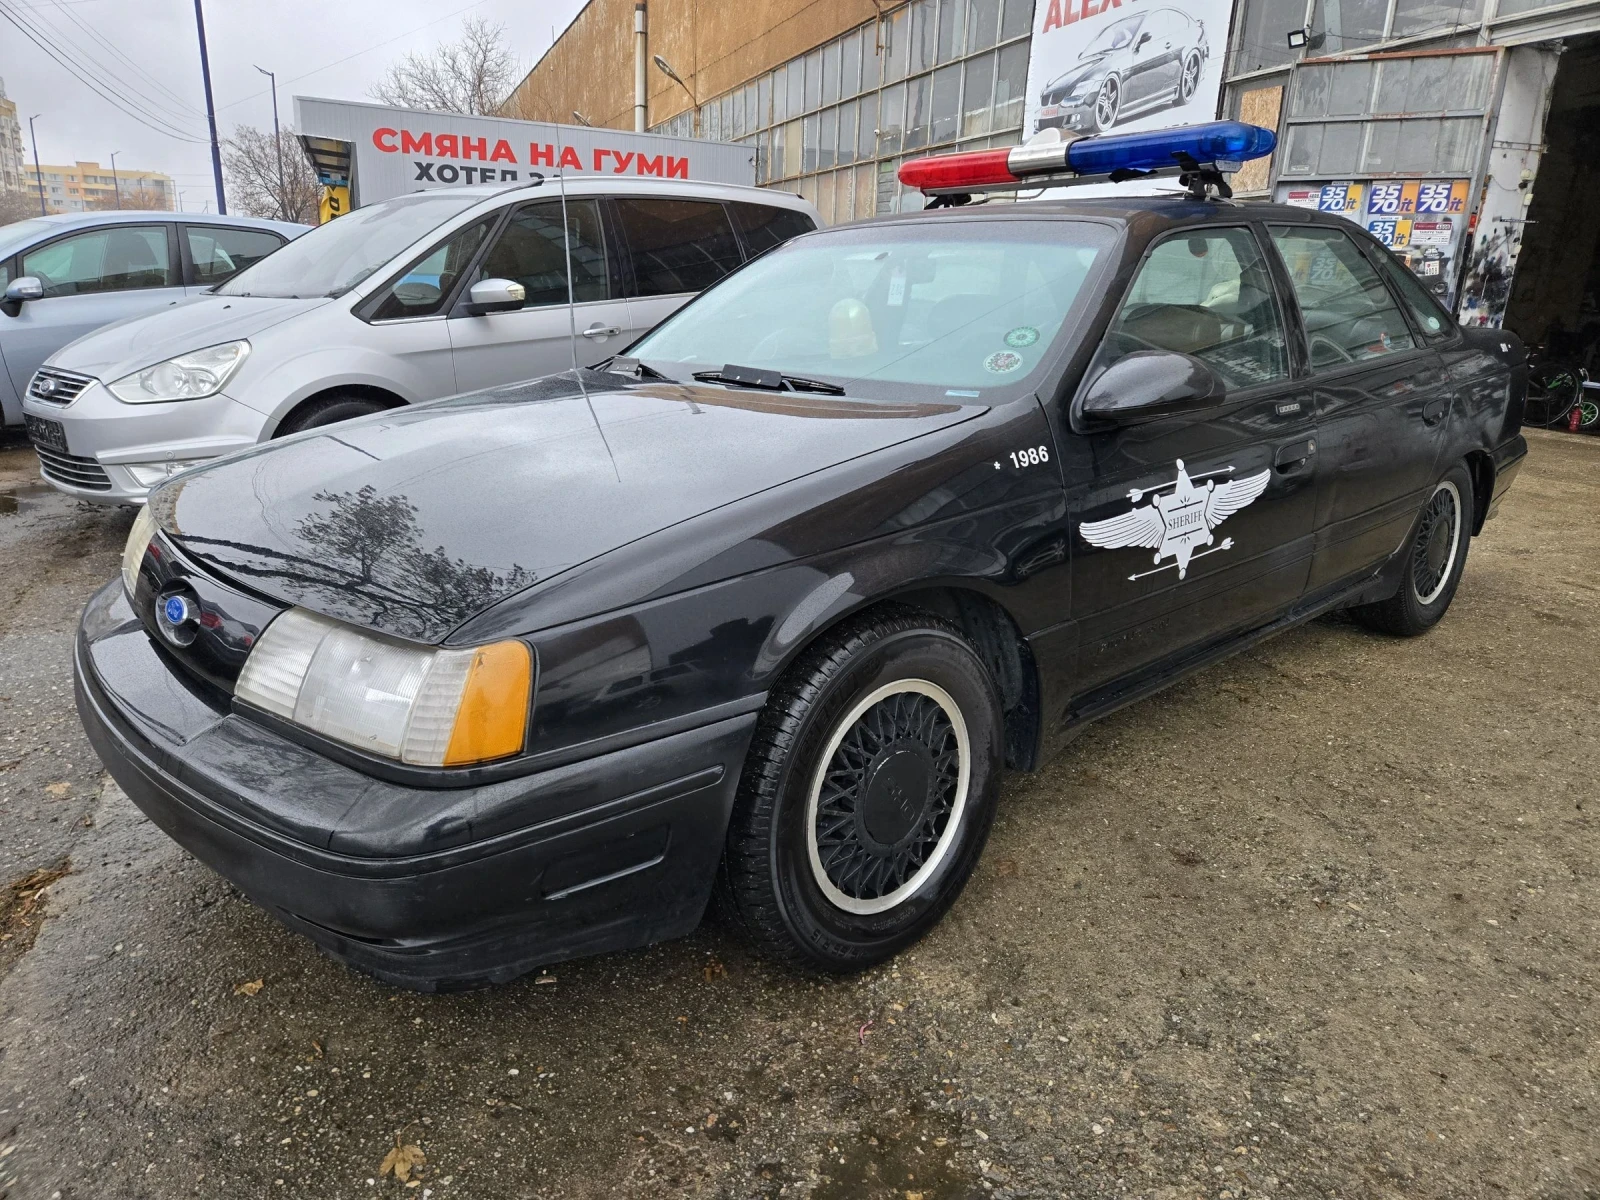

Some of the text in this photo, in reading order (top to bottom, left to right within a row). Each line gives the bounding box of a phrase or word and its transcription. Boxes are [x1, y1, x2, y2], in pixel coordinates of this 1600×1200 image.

[372, 127, 518, 164] СМЯНА
[529, 142, 583, 171] НА
[593, 148, 689, 180] ГУМИ
[1323, 186, 1347, 199] 35
[1371, 184, 1402, 199] 35
[1420, 183, 1451, 199] 35
[1370, 221, 1396, 234] 35
[1009, 445, 1049, 469] 1986
[1167, 510, 1203, 531] SHERIFF
